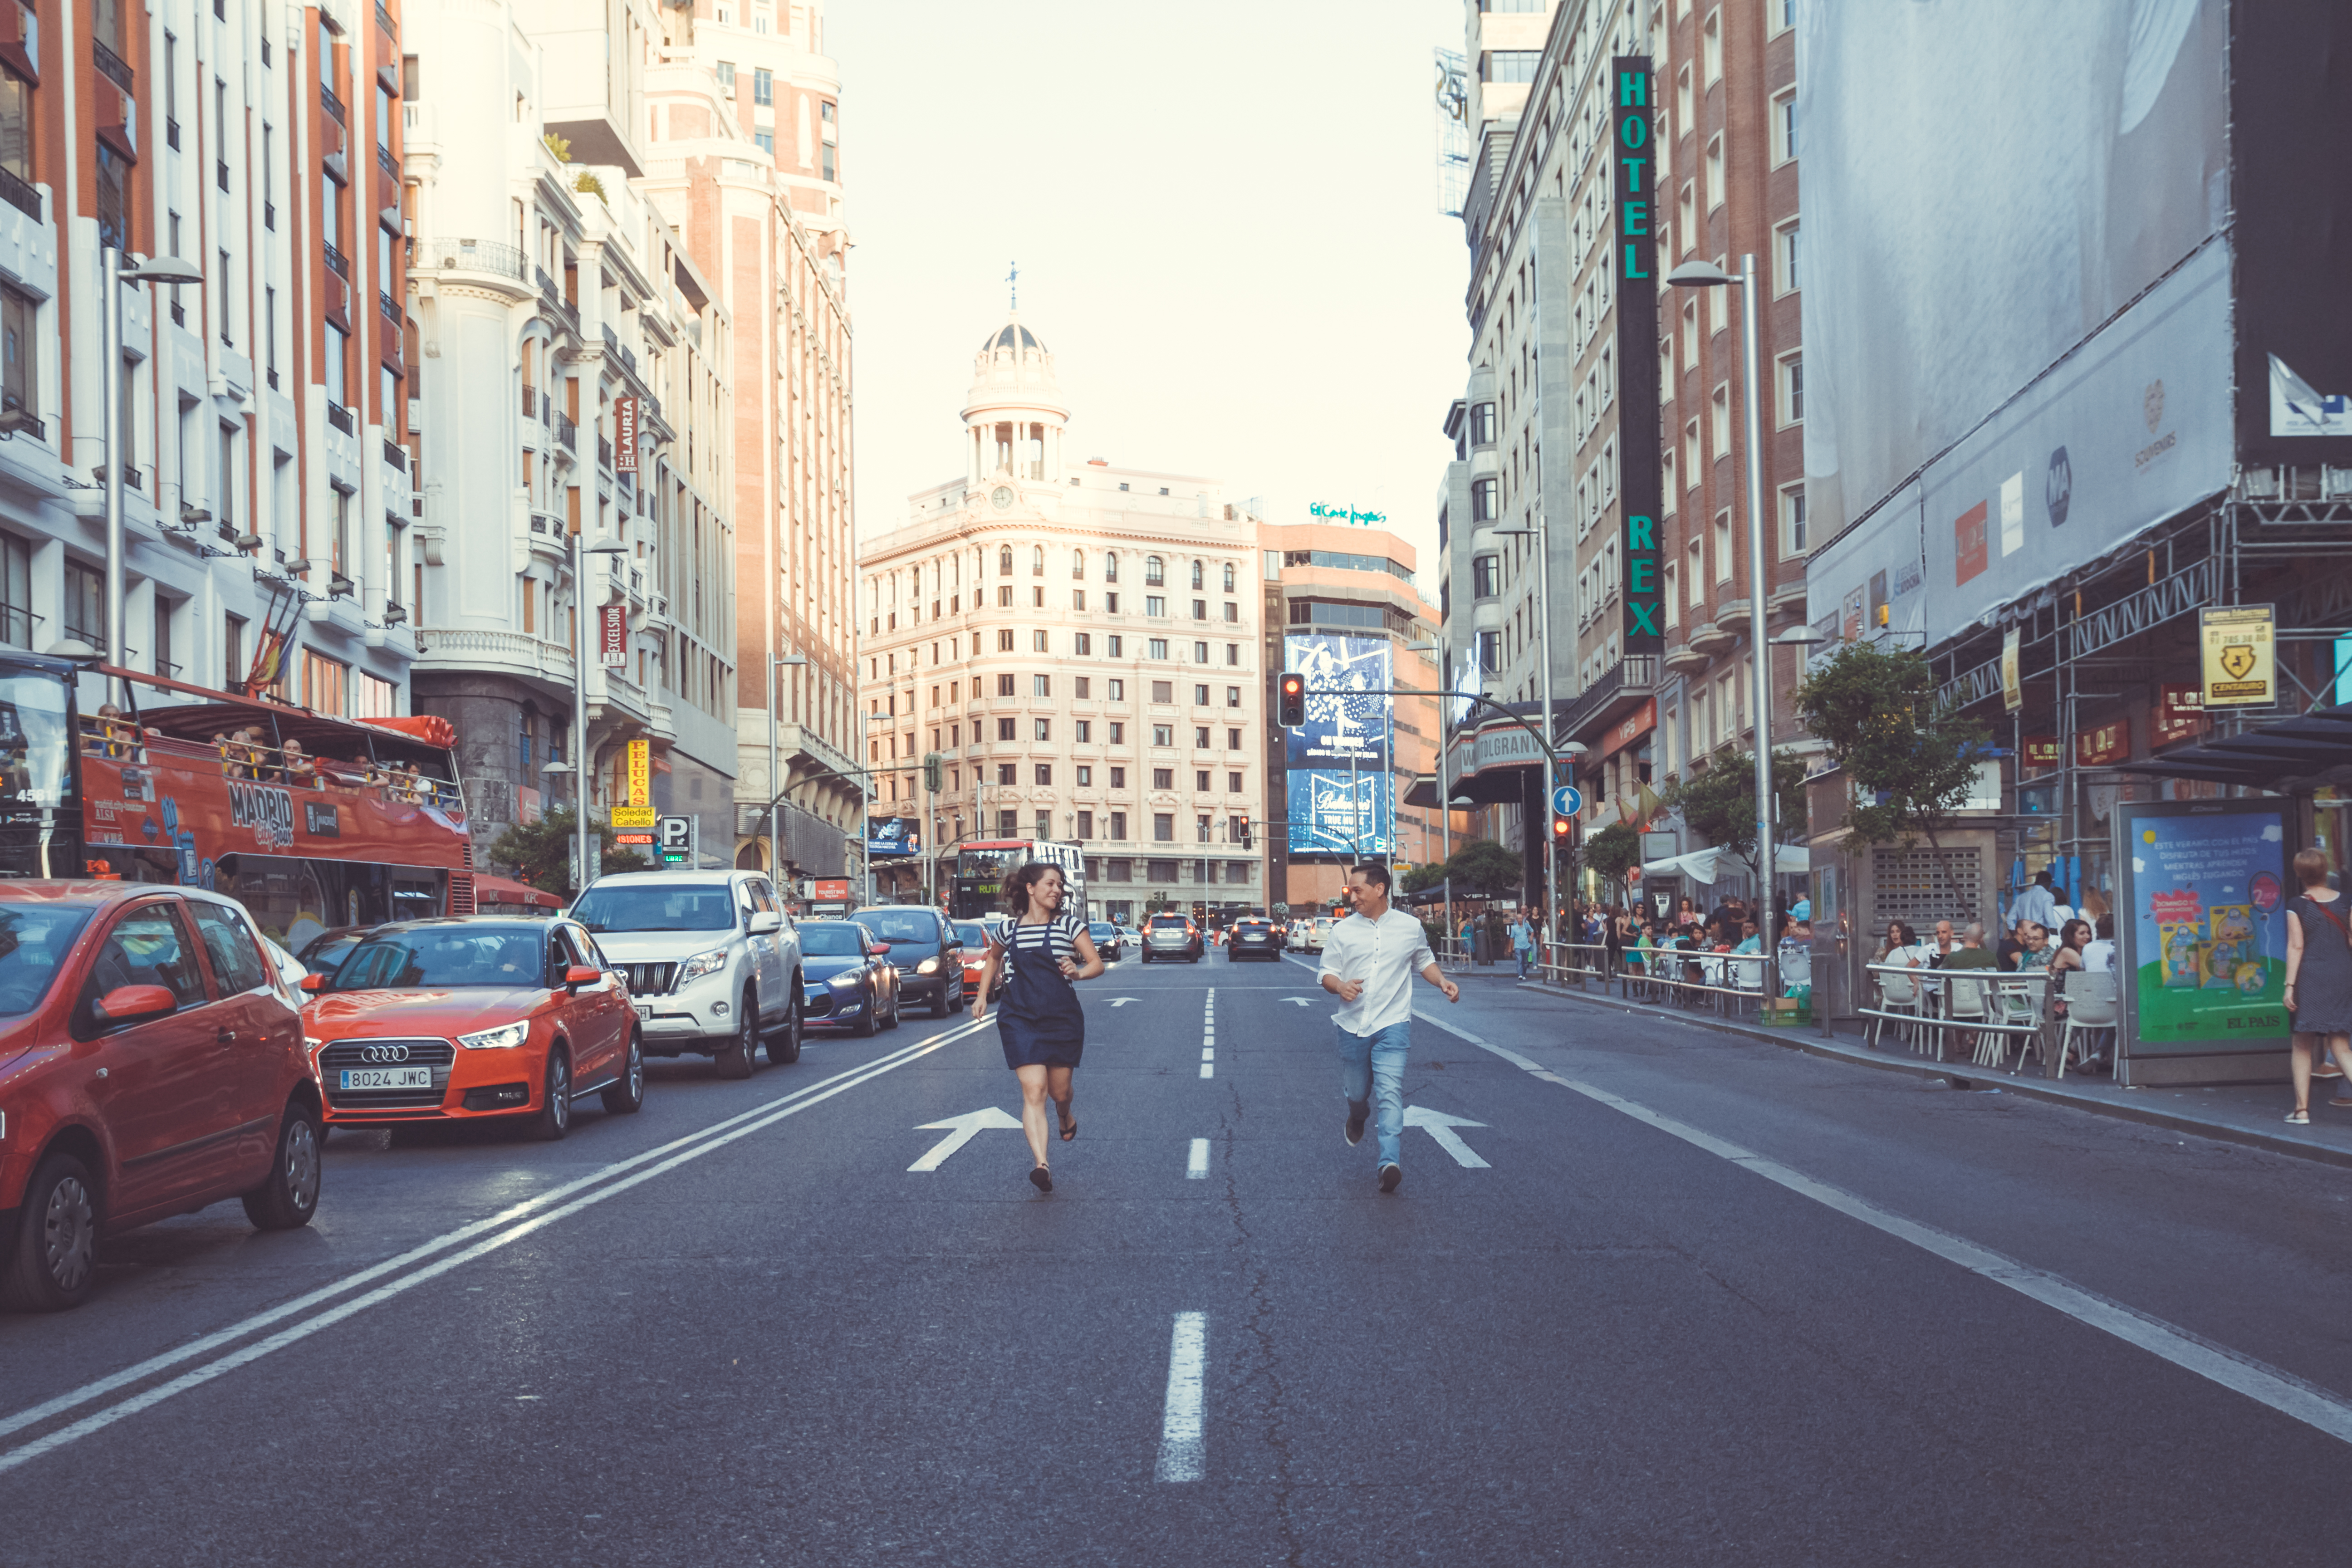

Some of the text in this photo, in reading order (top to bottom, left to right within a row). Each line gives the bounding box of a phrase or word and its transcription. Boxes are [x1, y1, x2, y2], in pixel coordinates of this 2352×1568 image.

[1620, 72, 1648, 278] HOTEL
[622, 400, 633, 454] LAURIA
[2135, 431, 2176, 467] SOUVENIRS
[1310, 502, 1321, 516] El
[1322, 504, 1348, 519] Corte
[1628, 515, 1660, 636] REX
[608, 608, 620, 652] EXCELSIOR
[1618, 717, 1635, 740] VIPS
[632, 742, 646, 805] PELUCAS
[16, 789, 53, 802] 4581
[228, 781, 294, 829] MADRID
[614, 808, 652, 816] Soledad
[95, 808, 115, 821] ALSA
[1323, 815, 1364, 825] TRUE MUC
[664, 818, 688, 846] P
[1328, 826, 1356, 834] FESTIVA
[2155, 841, 2174, 850] ESTE
[2160, 851, 2198, 860] DISFRUTA
[2163, 861, 2205, 870] MIENTRAS
[489, 892, 500, 902] KFC
[524, 892, 539, 904] KFC
[2227, 1018, 2245, 1029] EL
[352, 1071, 427, 1086] 8024 JWC
